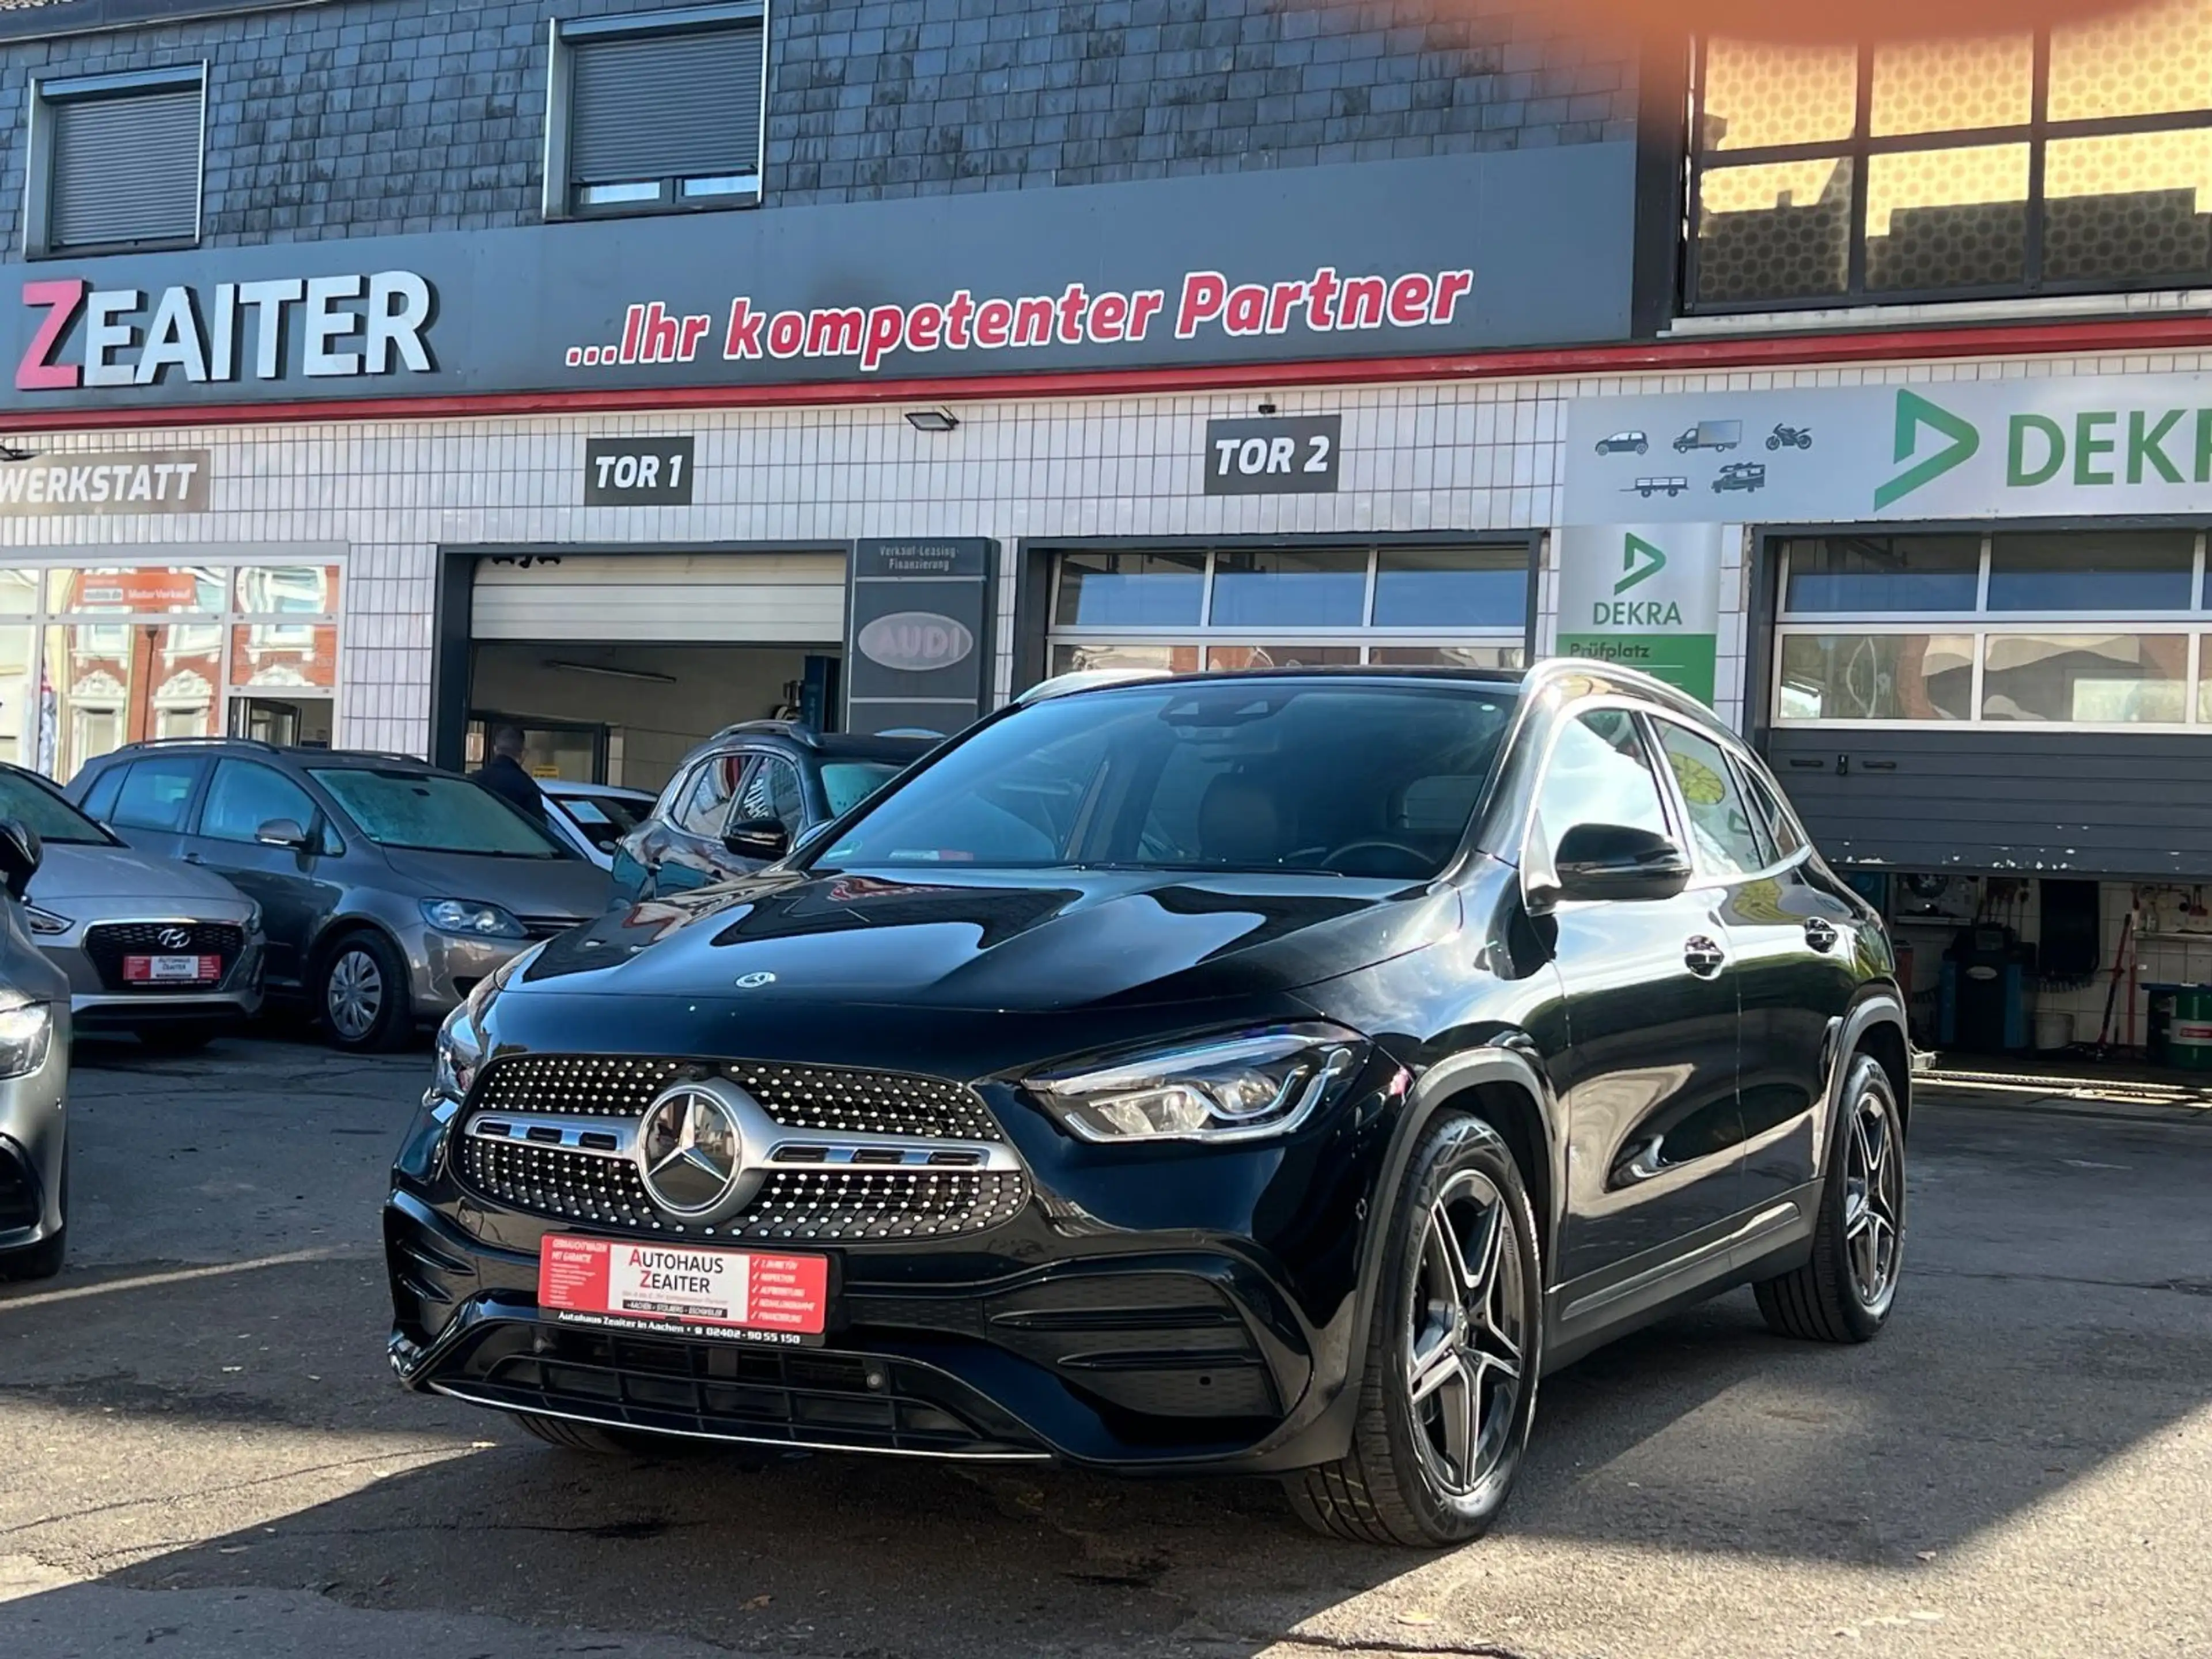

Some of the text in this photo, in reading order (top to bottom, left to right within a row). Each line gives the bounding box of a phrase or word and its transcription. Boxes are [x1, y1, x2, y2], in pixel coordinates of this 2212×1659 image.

[15, 270, 432, 391] ZEAITER
[566, 267, 1474, 371] ...Ihr kompetenter Partner
[595, 454, 683, 488] TOR 1
[1215, 435, 1330, 476] TOR 2
[0, 463, 198, 503] WERKSTATT
[1592, 601, 1683, 626] DEKRA
[875, 624, 961, 658] AUDI
[1569, 642, 1650, 661] Prüfplatz
[628, 1248, 724, 1274] AUTOHAUS
[639, 1270, 710, 1294] ZEAITER
[558, 1311, 602, 1324] Autohaus
[603, 1316, 636, 1328] Zeaiter
[637, 1320, 647, 1329] in
[648, 1321, 684, 1333] Aachen
